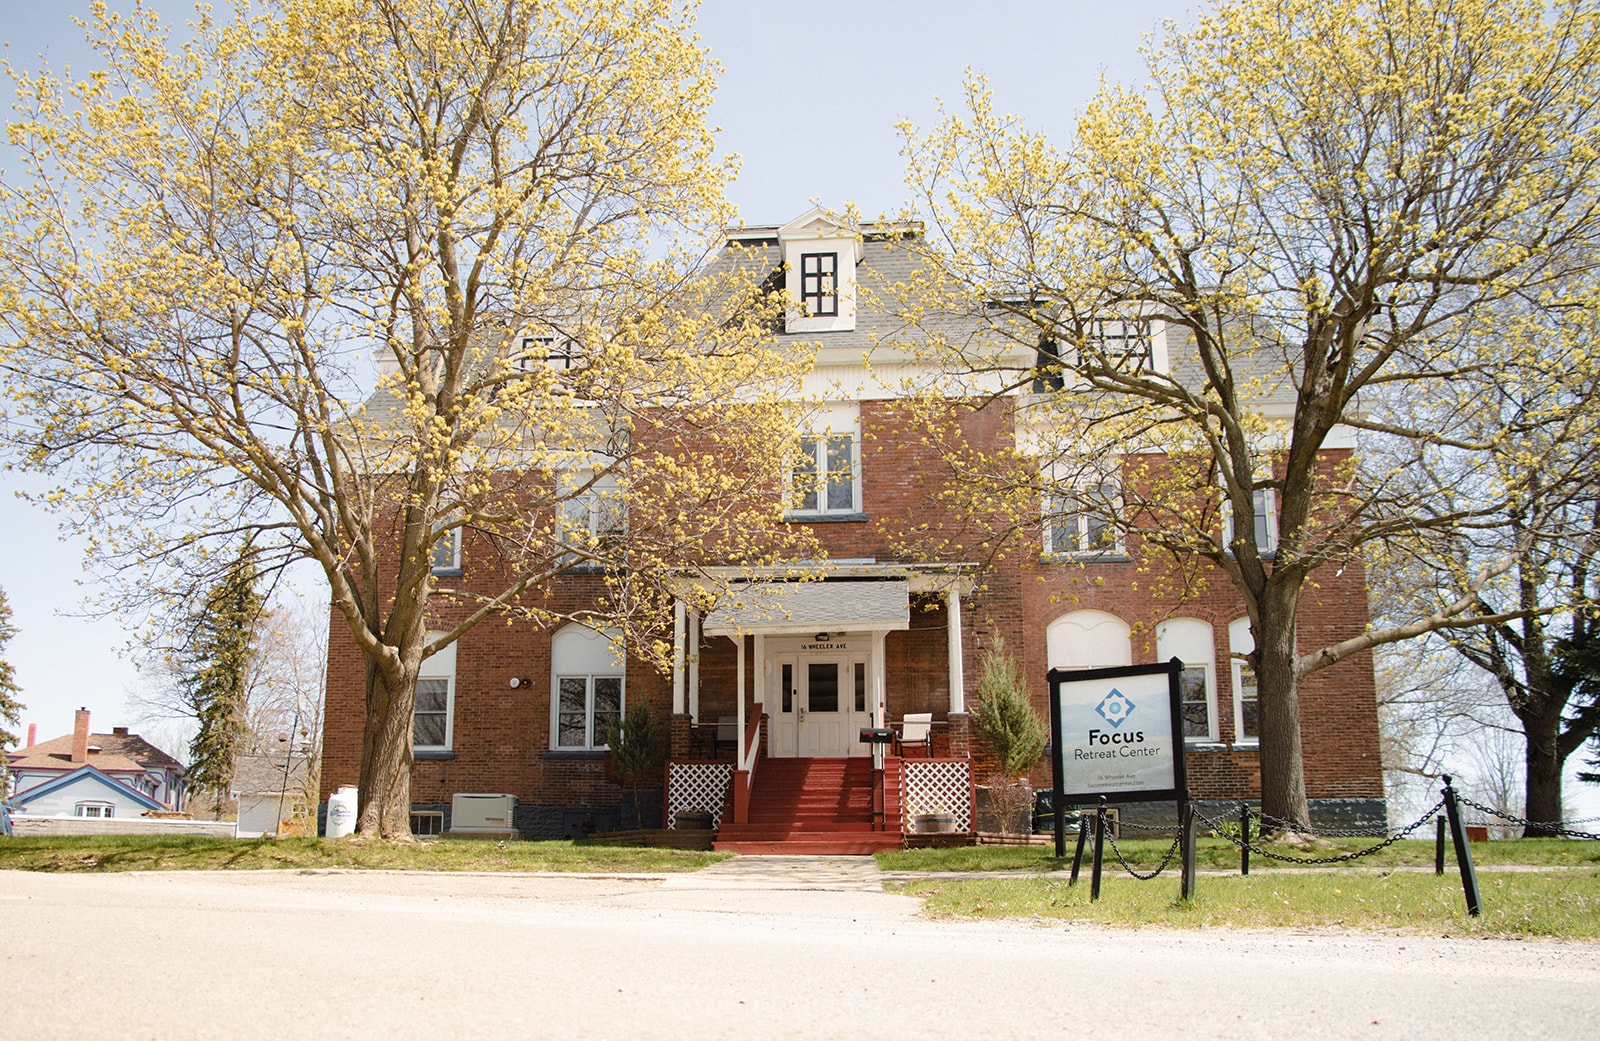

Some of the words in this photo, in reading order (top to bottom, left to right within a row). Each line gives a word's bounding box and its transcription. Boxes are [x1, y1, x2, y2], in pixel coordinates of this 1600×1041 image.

[1088, 729, 1144, 746] Focus
[1074, 748, 1117, 760] Retreat
[1119, 745, 1161, 757] Center
